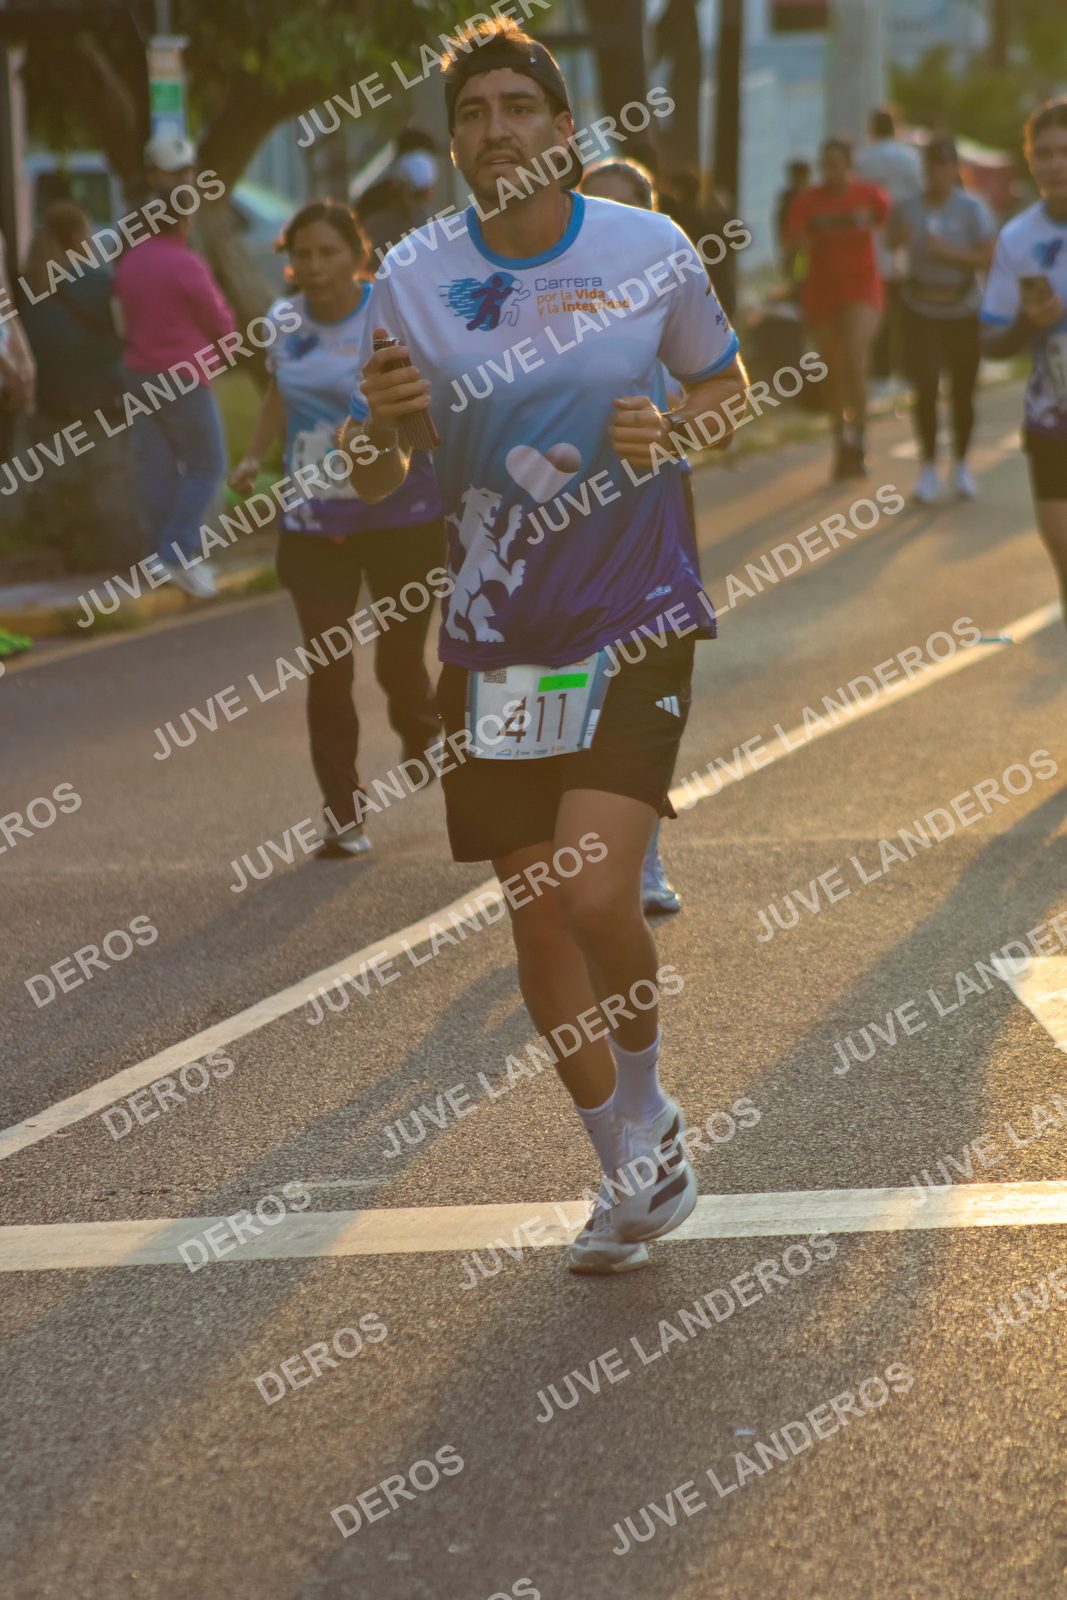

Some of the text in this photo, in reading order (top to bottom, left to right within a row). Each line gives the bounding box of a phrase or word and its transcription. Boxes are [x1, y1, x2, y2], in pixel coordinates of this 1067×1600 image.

[535, 277, 602, 291] Carrera
[536, 288, 605, 305] por la Vida
[537, 307, 544, 318] y
[548, 304, 559, 313] la
[496, 693, 567, 743] 411
